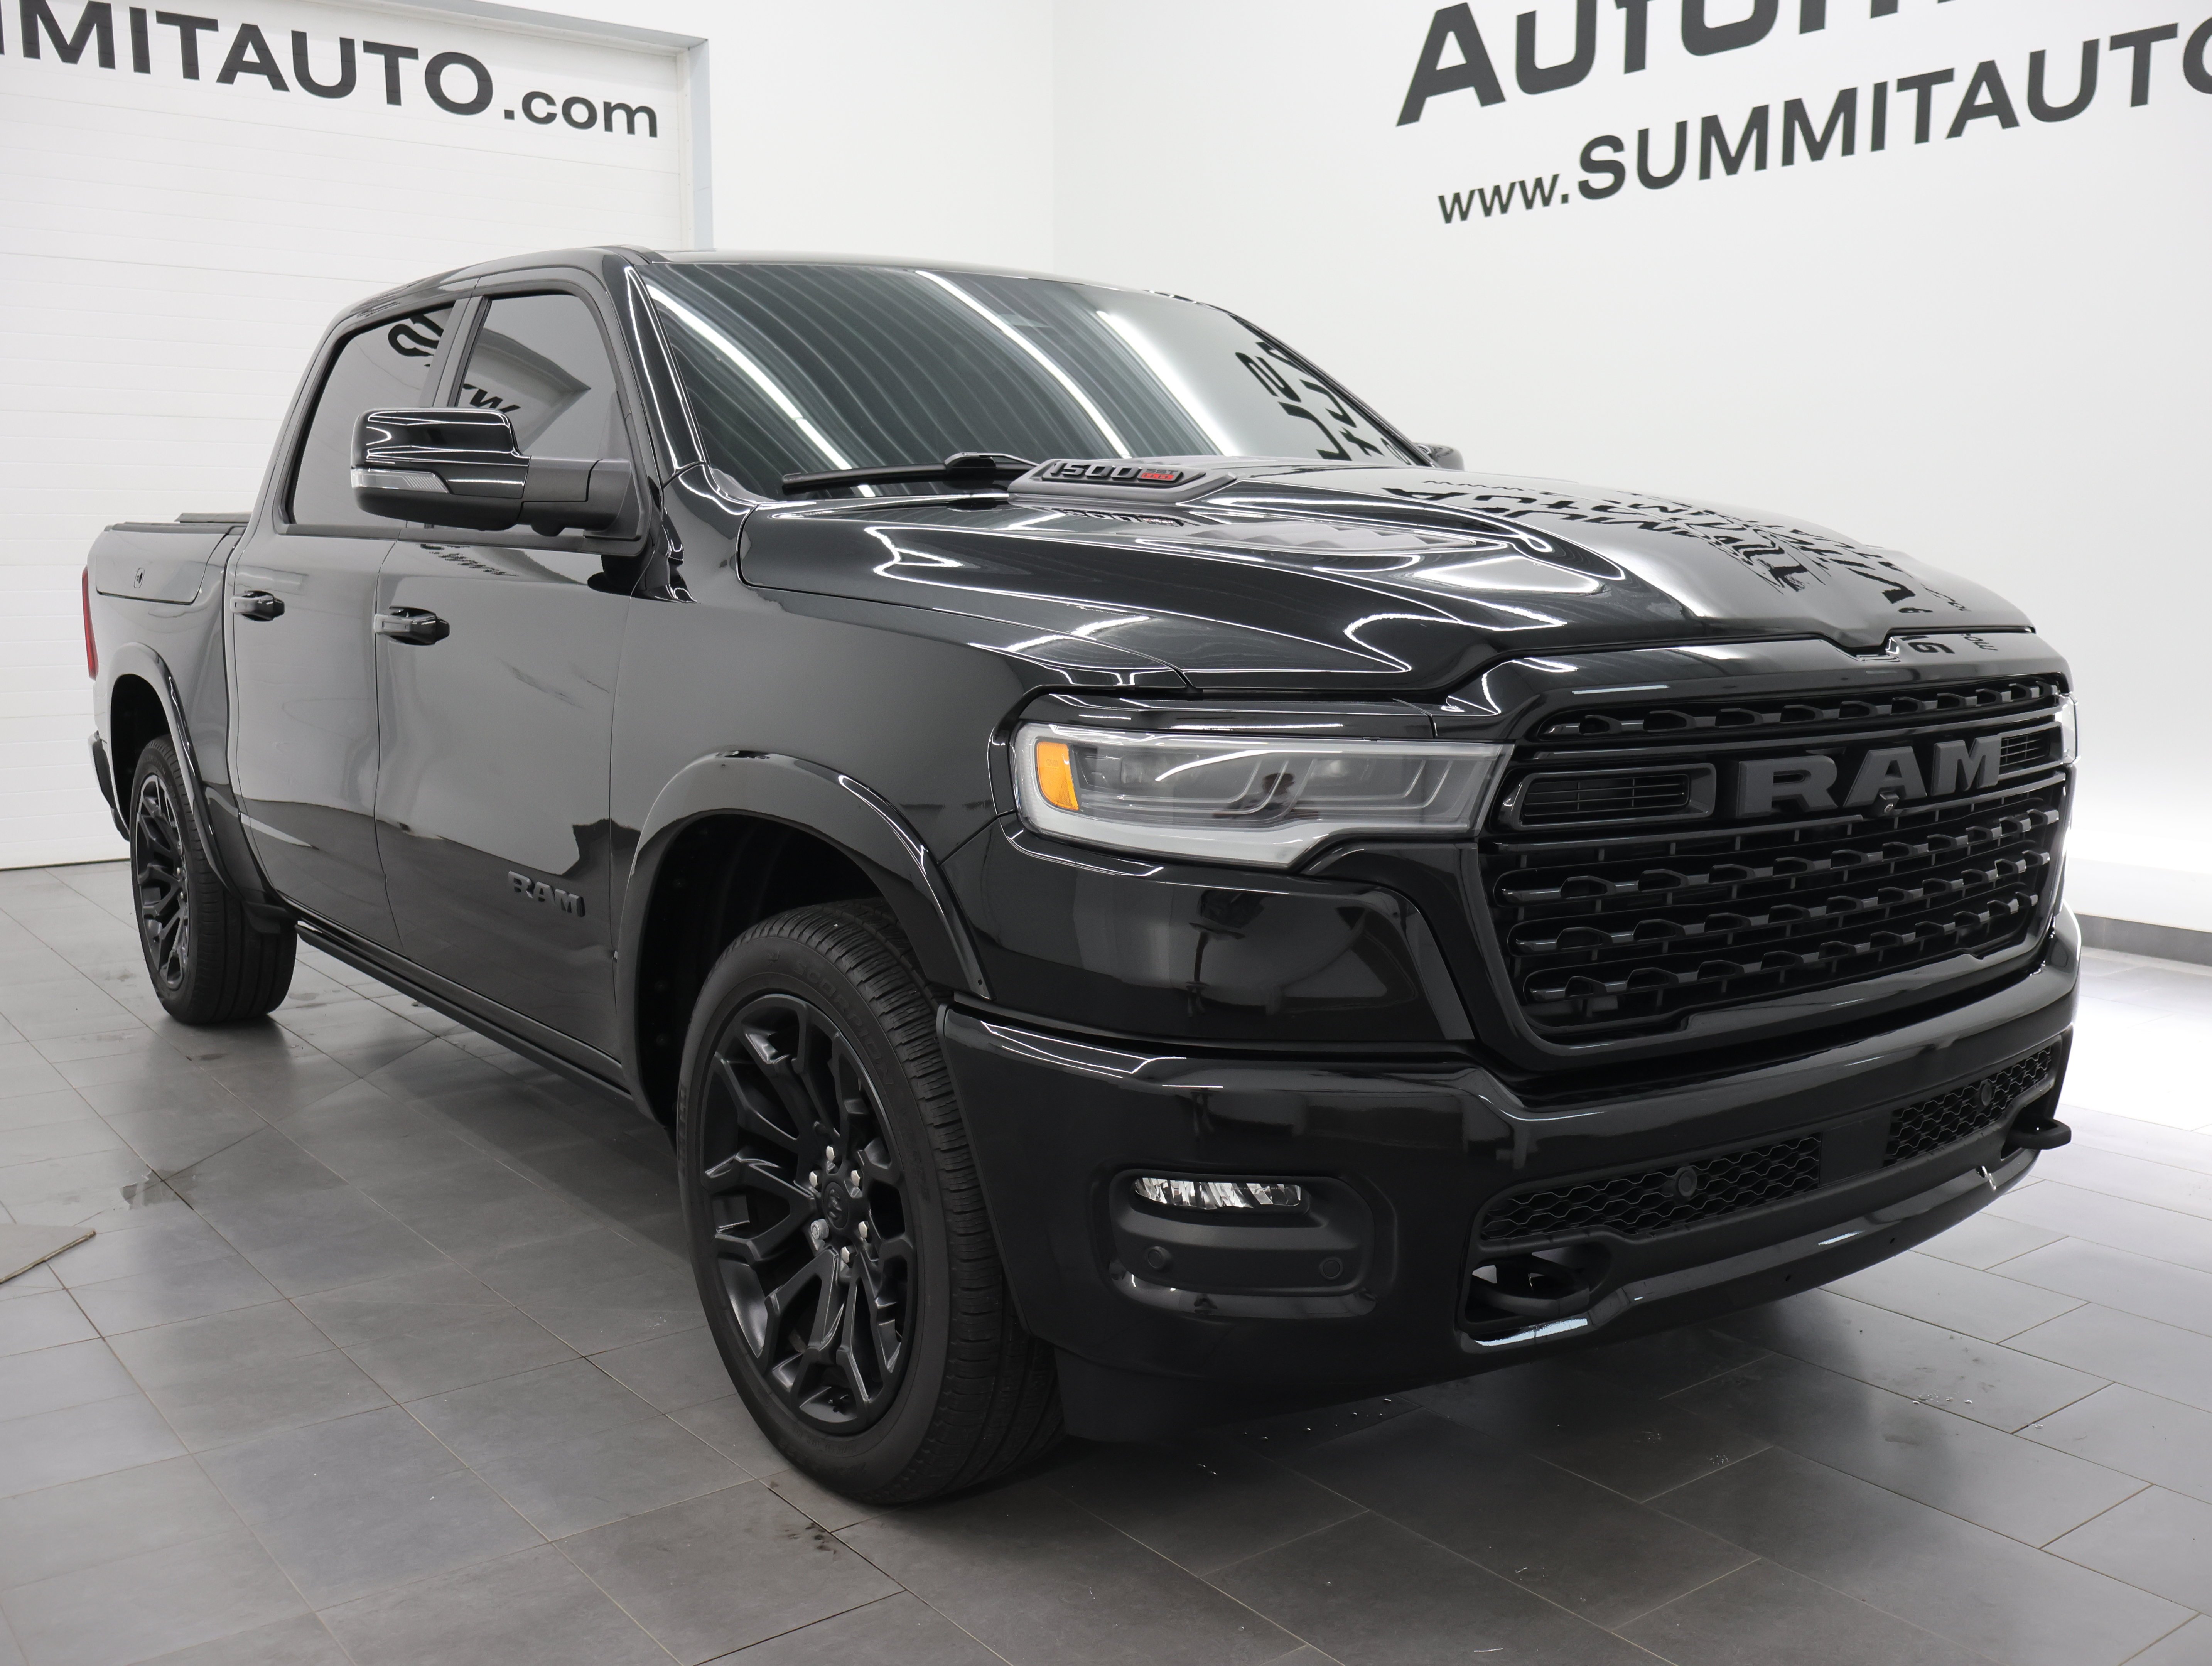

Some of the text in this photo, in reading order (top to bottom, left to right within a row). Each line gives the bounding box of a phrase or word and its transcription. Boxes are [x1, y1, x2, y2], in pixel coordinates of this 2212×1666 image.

[0, 0, 657, 137] MITAUTO.com
[1050, 462, 1142, 479] 1500
[1738, 734, 2003, 818] RAM
[508, 870, 585, 917] RAM
